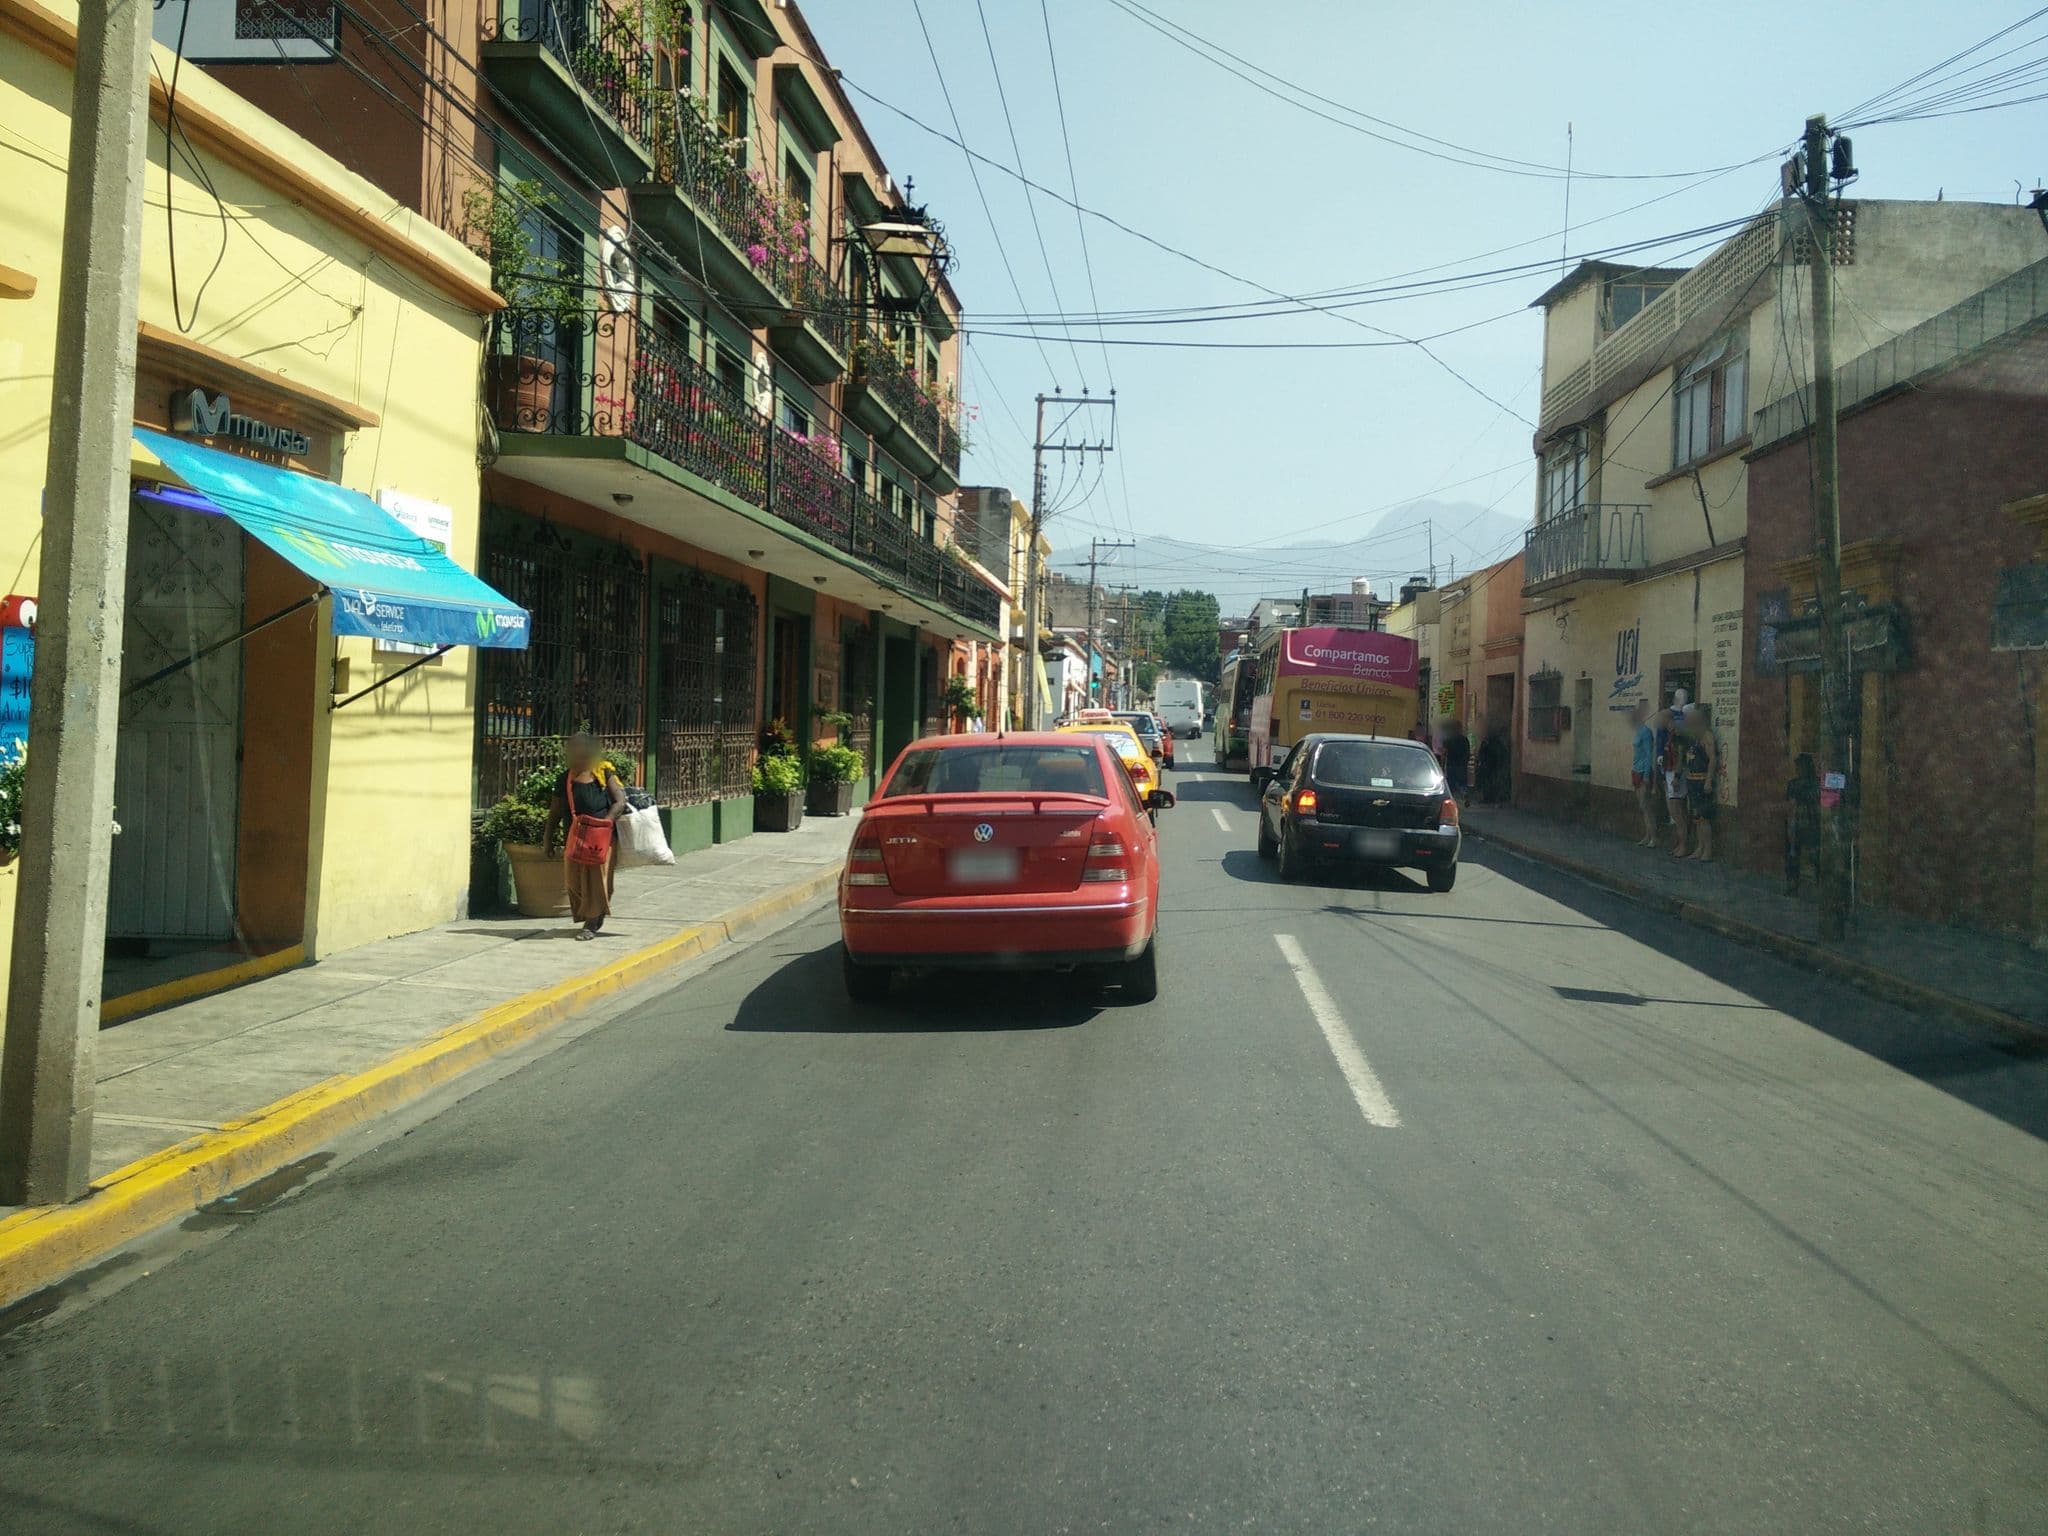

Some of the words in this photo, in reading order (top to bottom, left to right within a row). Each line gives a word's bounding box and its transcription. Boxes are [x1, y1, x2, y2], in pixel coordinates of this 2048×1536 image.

[231, 413, 311, 455] movistar
[375, 604, 404, 620] SERVICE
[495, 614, 526, 629] movistar
[5, 635, 34, 662] Supe
[1304, 644, 1390, 665] Compartamos
[1353, 663, 1389, 679] Banco
[1301, 678, 1355, 694] Beneficios
[1355, 681, 1392, 698] Únicos
[1328, 711, 1345, 720] 800
